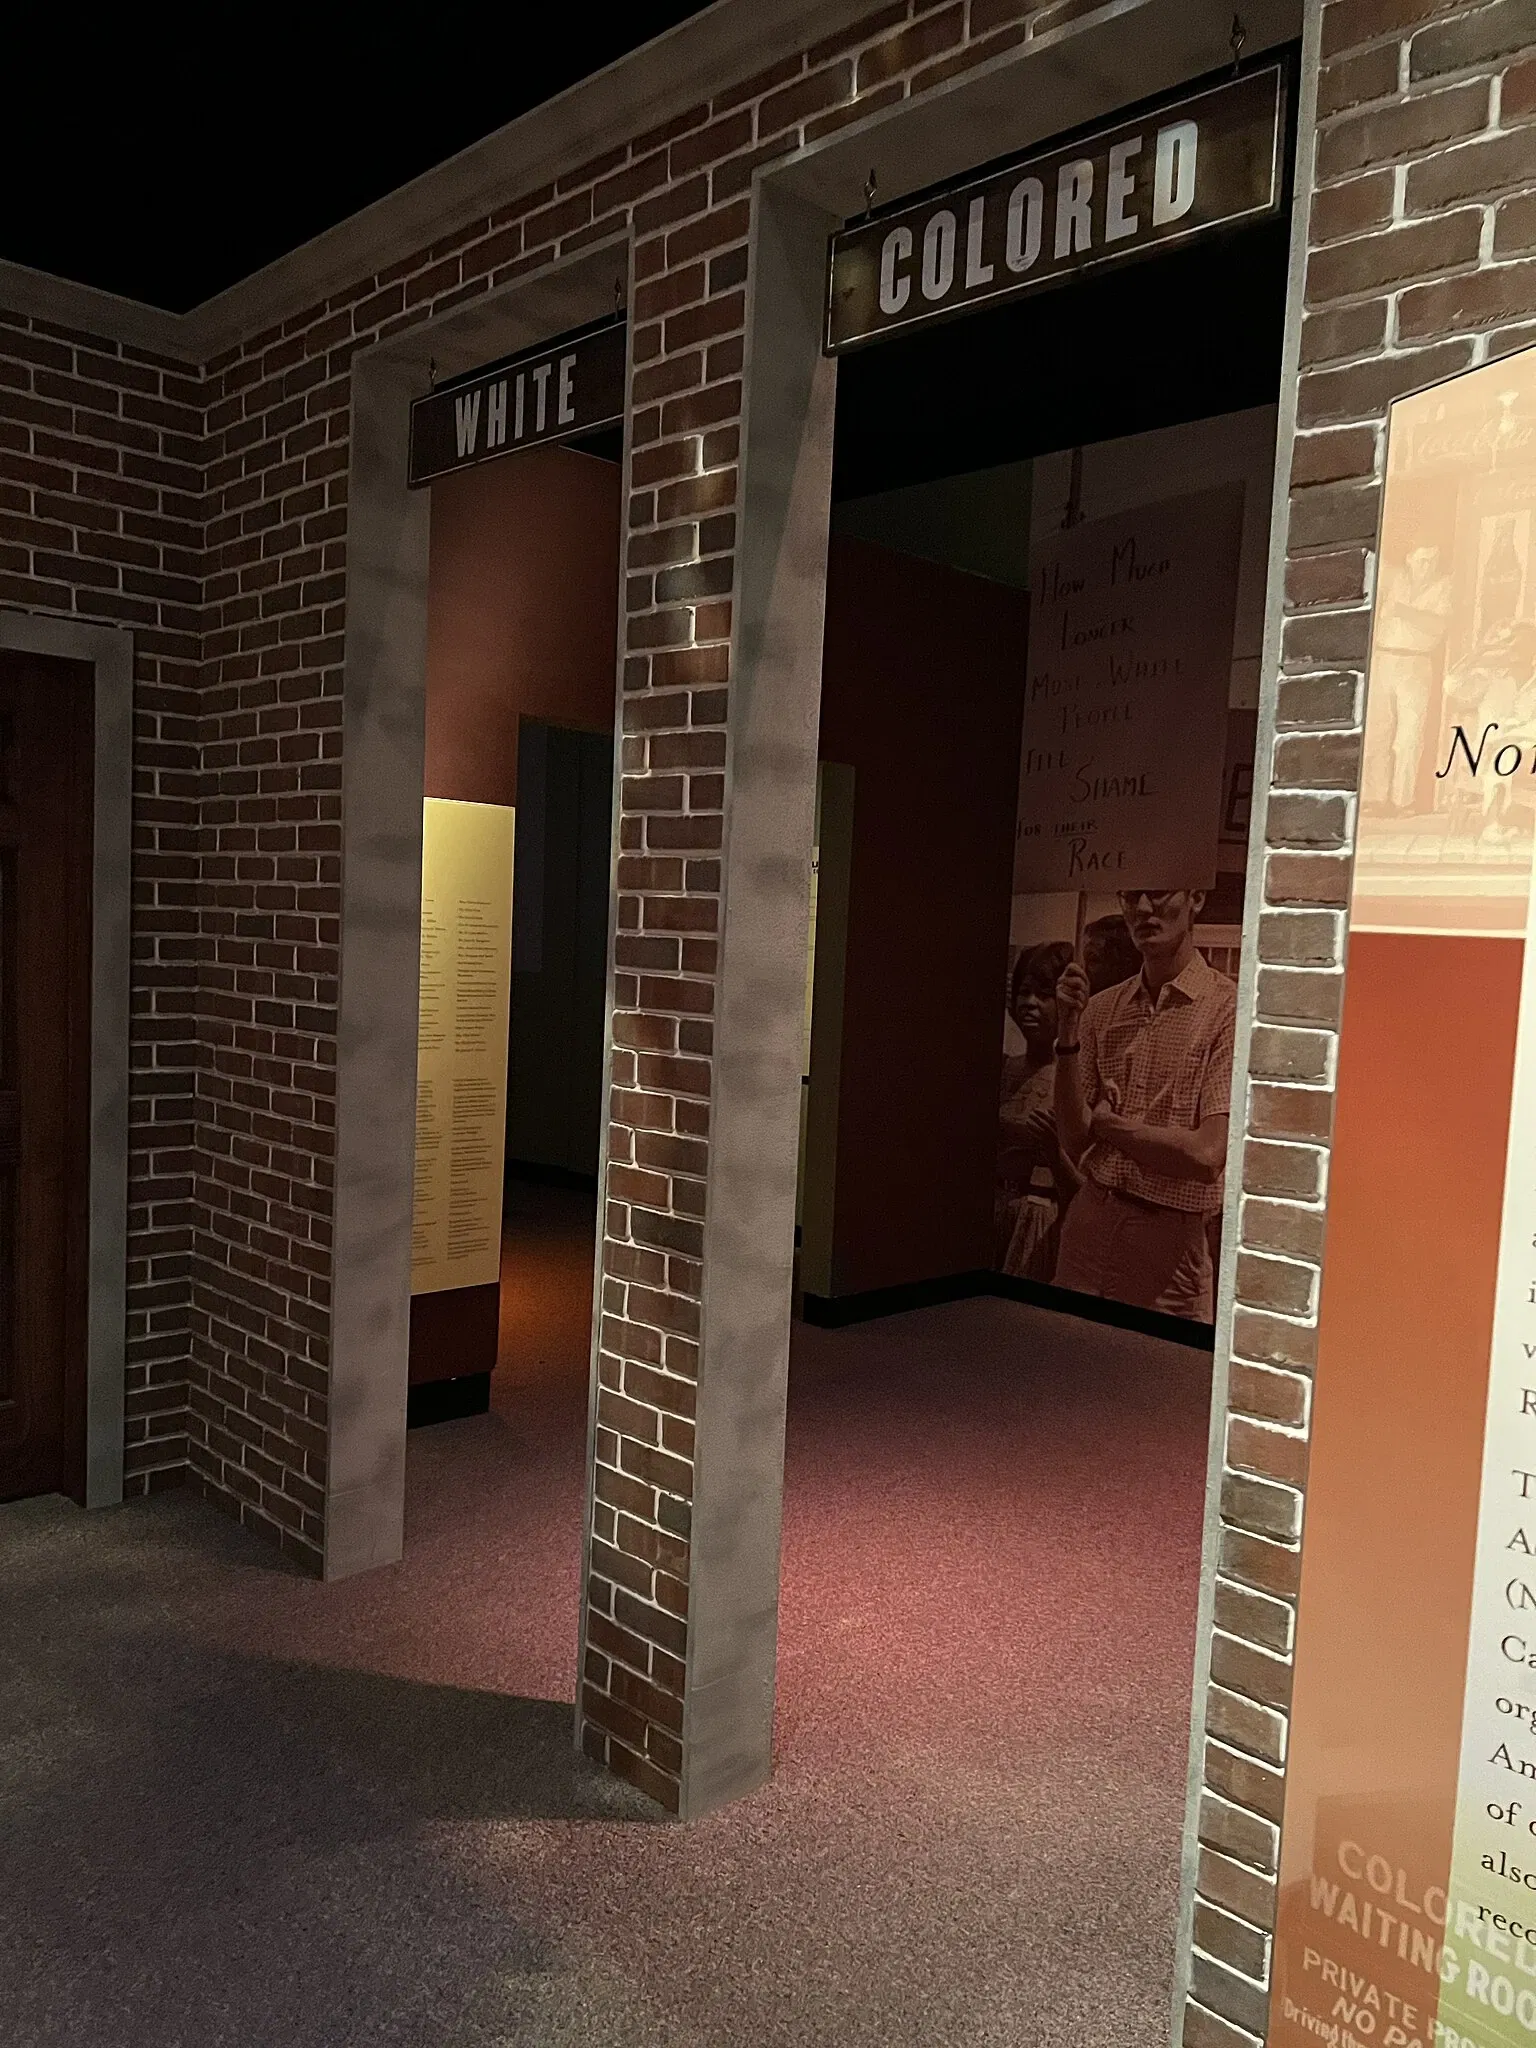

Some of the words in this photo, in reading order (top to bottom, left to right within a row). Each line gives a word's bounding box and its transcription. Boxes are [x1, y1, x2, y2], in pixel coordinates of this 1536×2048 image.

[878, 119, 1200, 315] COLORED
[453, 353, 577, 458] WHITE
[1069, 754, 1160, 803] SHAME
[1067, 837, 1128, 878] RACE
[1486, 1801, 1523, 1827] of
[1309, 1873, 1461, 1984] WAITING
[1302, 1946, 1419, 2030] PRIVATE
[1331, 1996, 1377, 2035] NO
